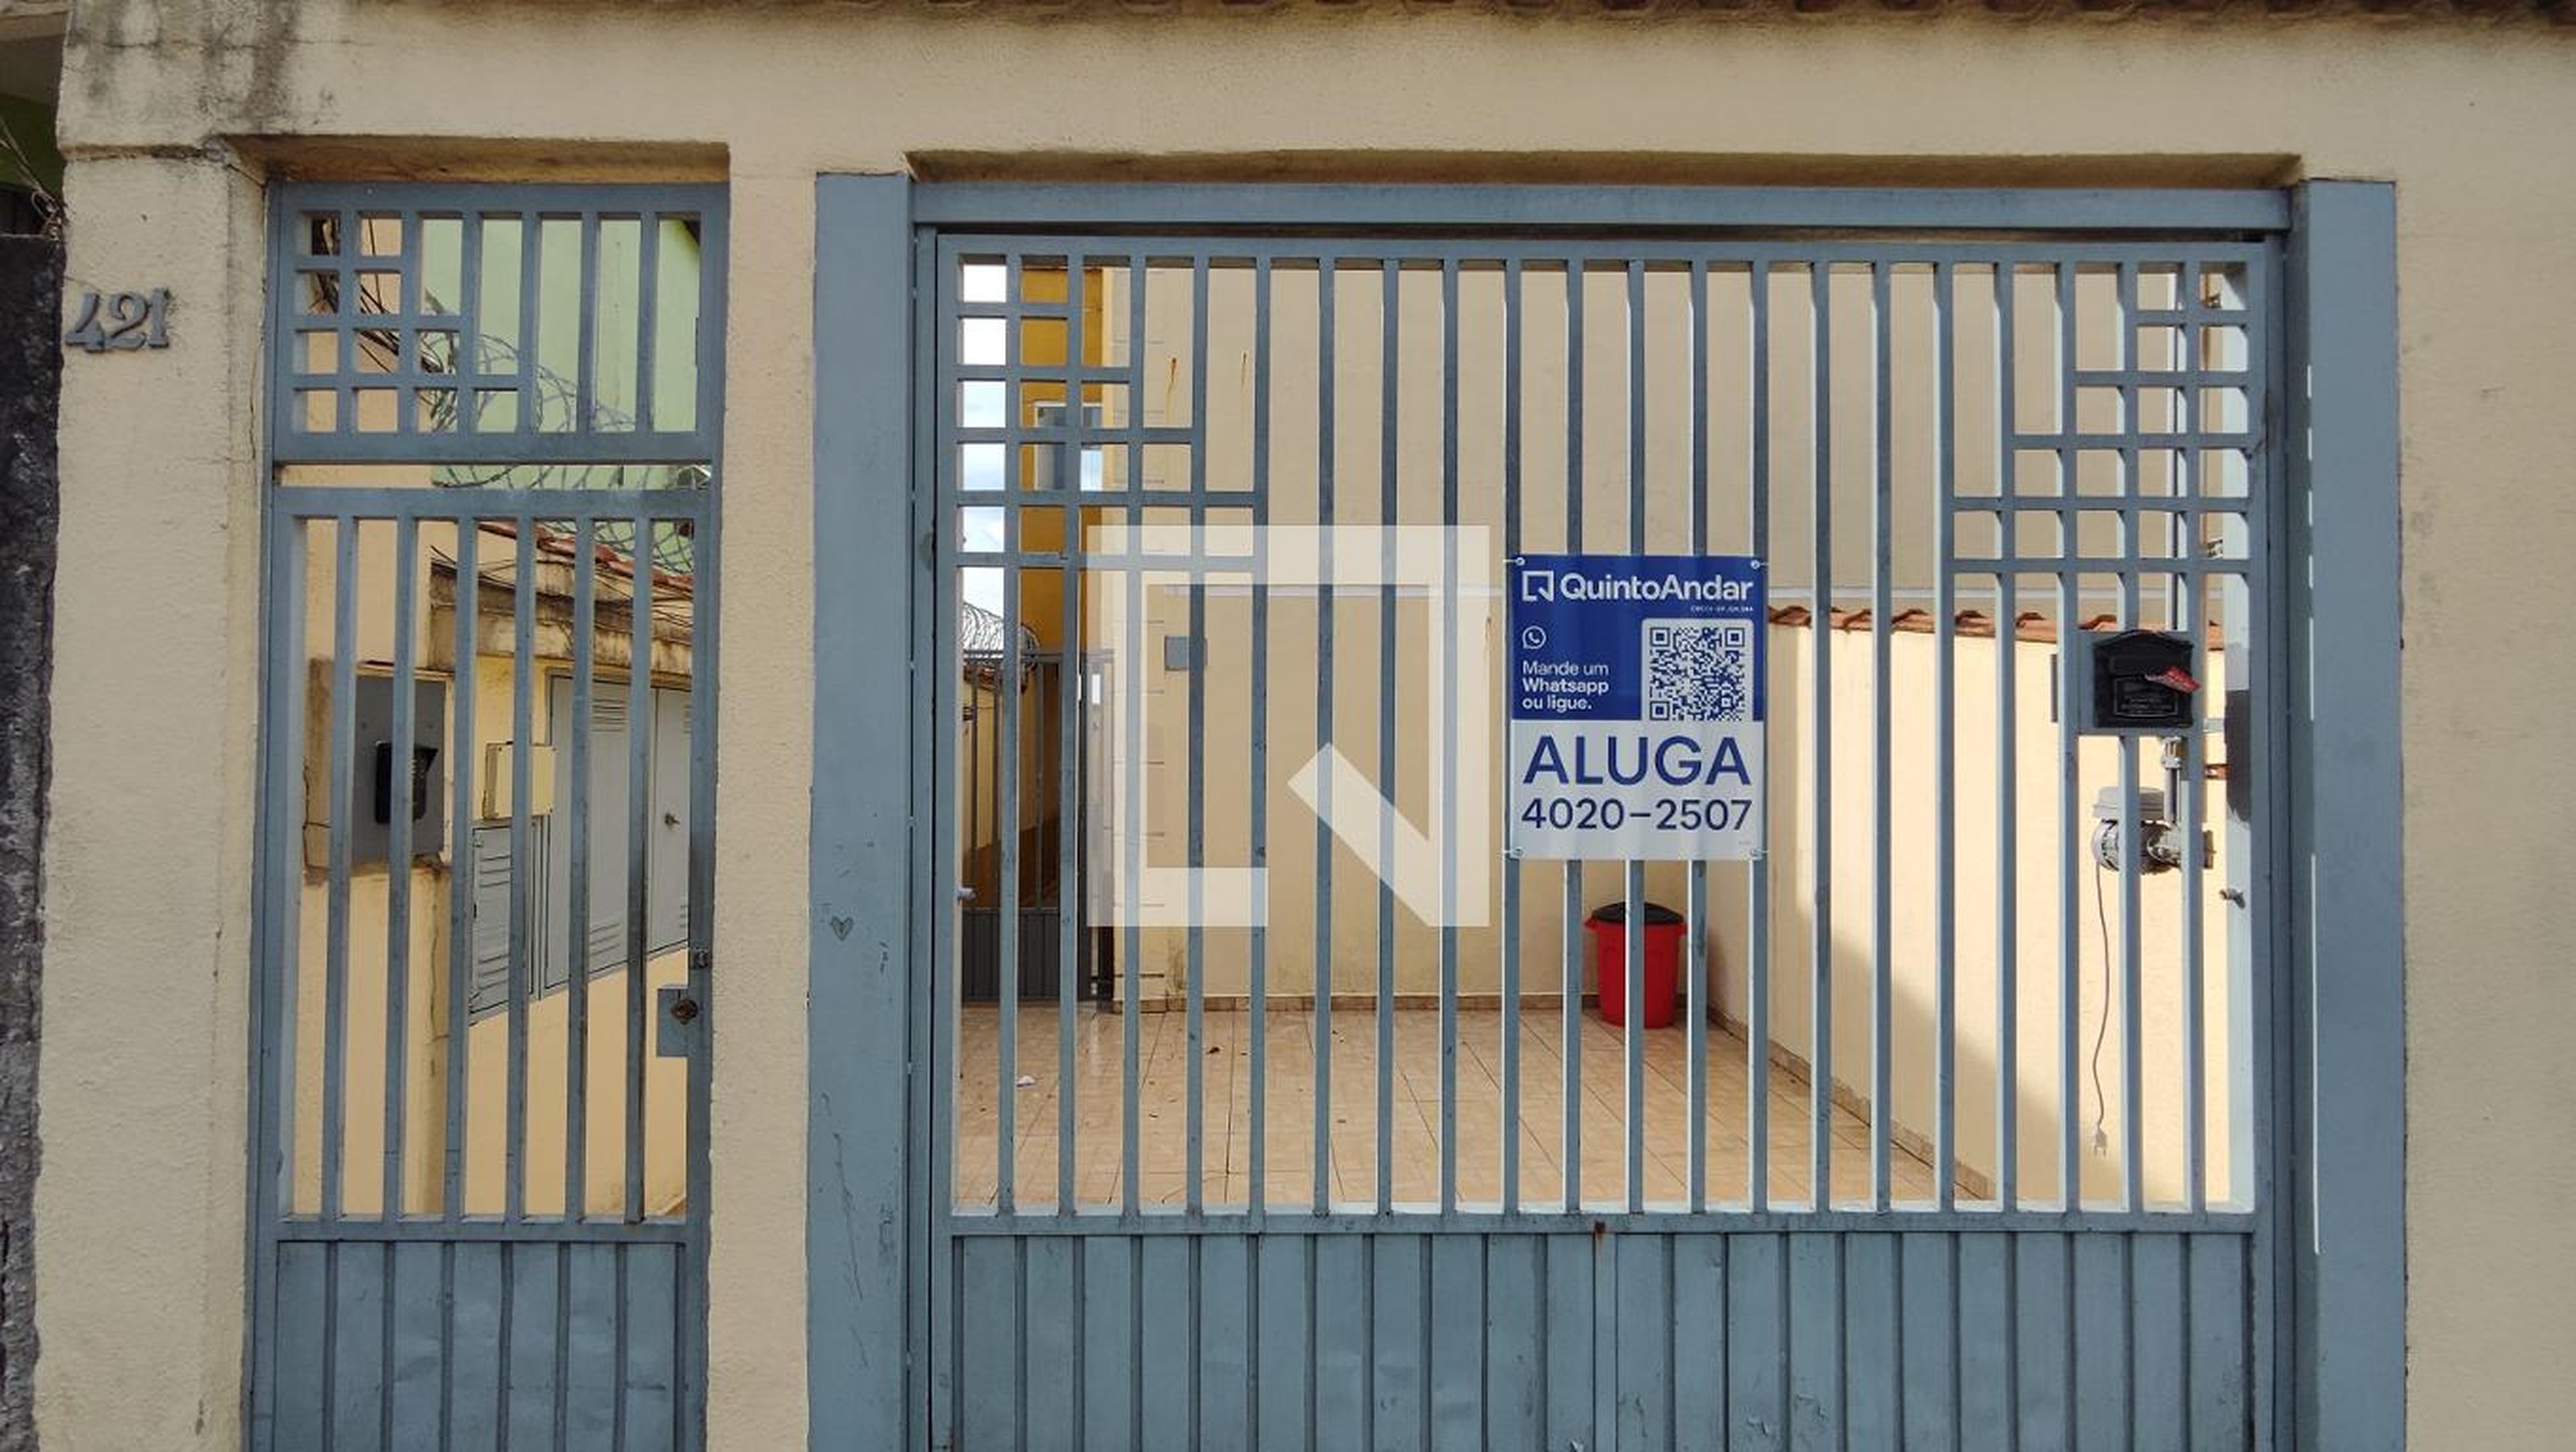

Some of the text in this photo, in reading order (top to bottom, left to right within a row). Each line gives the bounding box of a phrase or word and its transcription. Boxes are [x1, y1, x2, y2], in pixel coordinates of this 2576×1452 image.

[65, 288, 169, 352] 421
[1560, 572, 1753, 601] QuintoAndar
[1522, 660, 1609, 676] Mande um
[1522, 677, 1609, 694] Whatsapp
[1522, 694, 1592, 712] ou ligue.
[1523, 736, 1752, 785] ALUGA
[1521, 798, 1752, 831] 4020-2507
